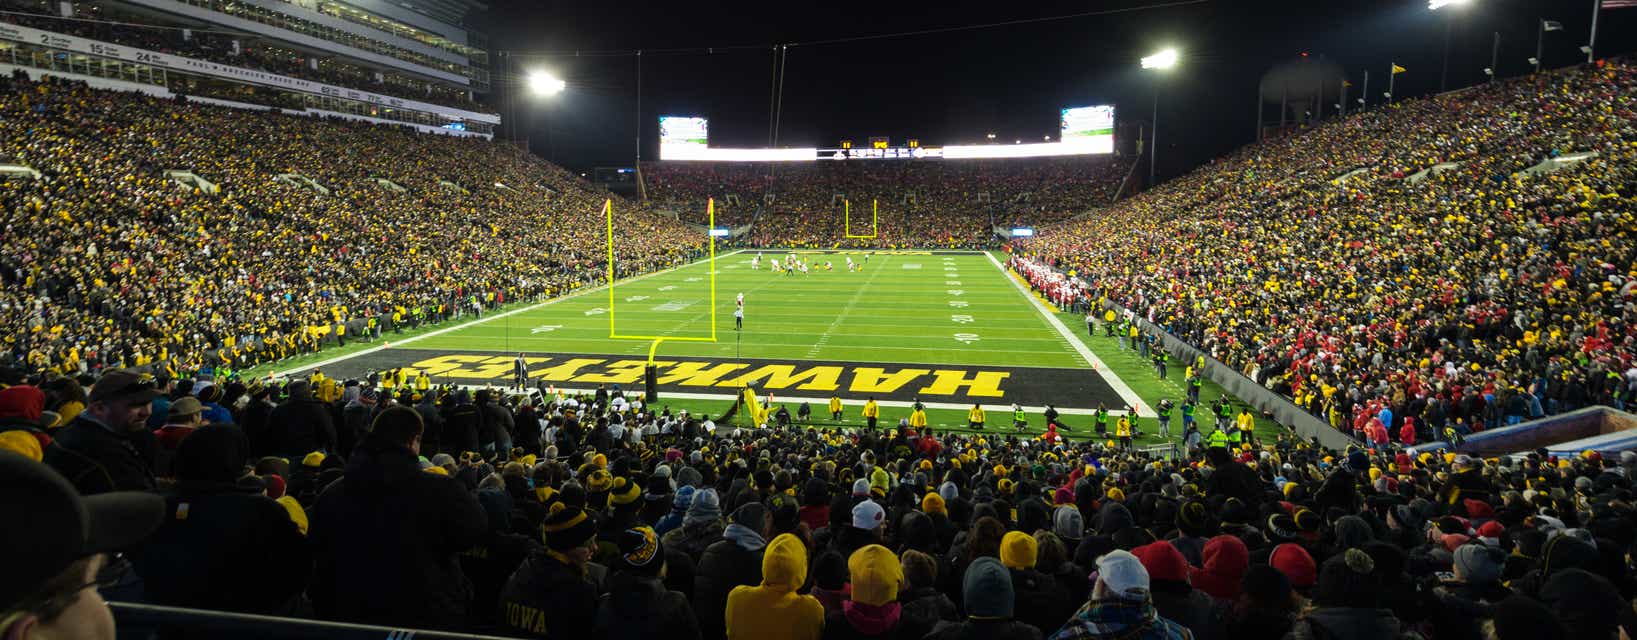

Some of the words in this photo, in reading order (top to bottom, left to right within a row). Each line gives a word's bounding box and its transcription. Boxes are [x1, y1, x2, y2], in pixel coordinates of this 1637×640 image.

[41, 34, 49, 44] 2
[90, 43, 104, 54] 15
[136, 52, 151, 62] 24
[409, 354, 1011, 397] HAWKEYES
[505, 601, 546, 633] IOWA
